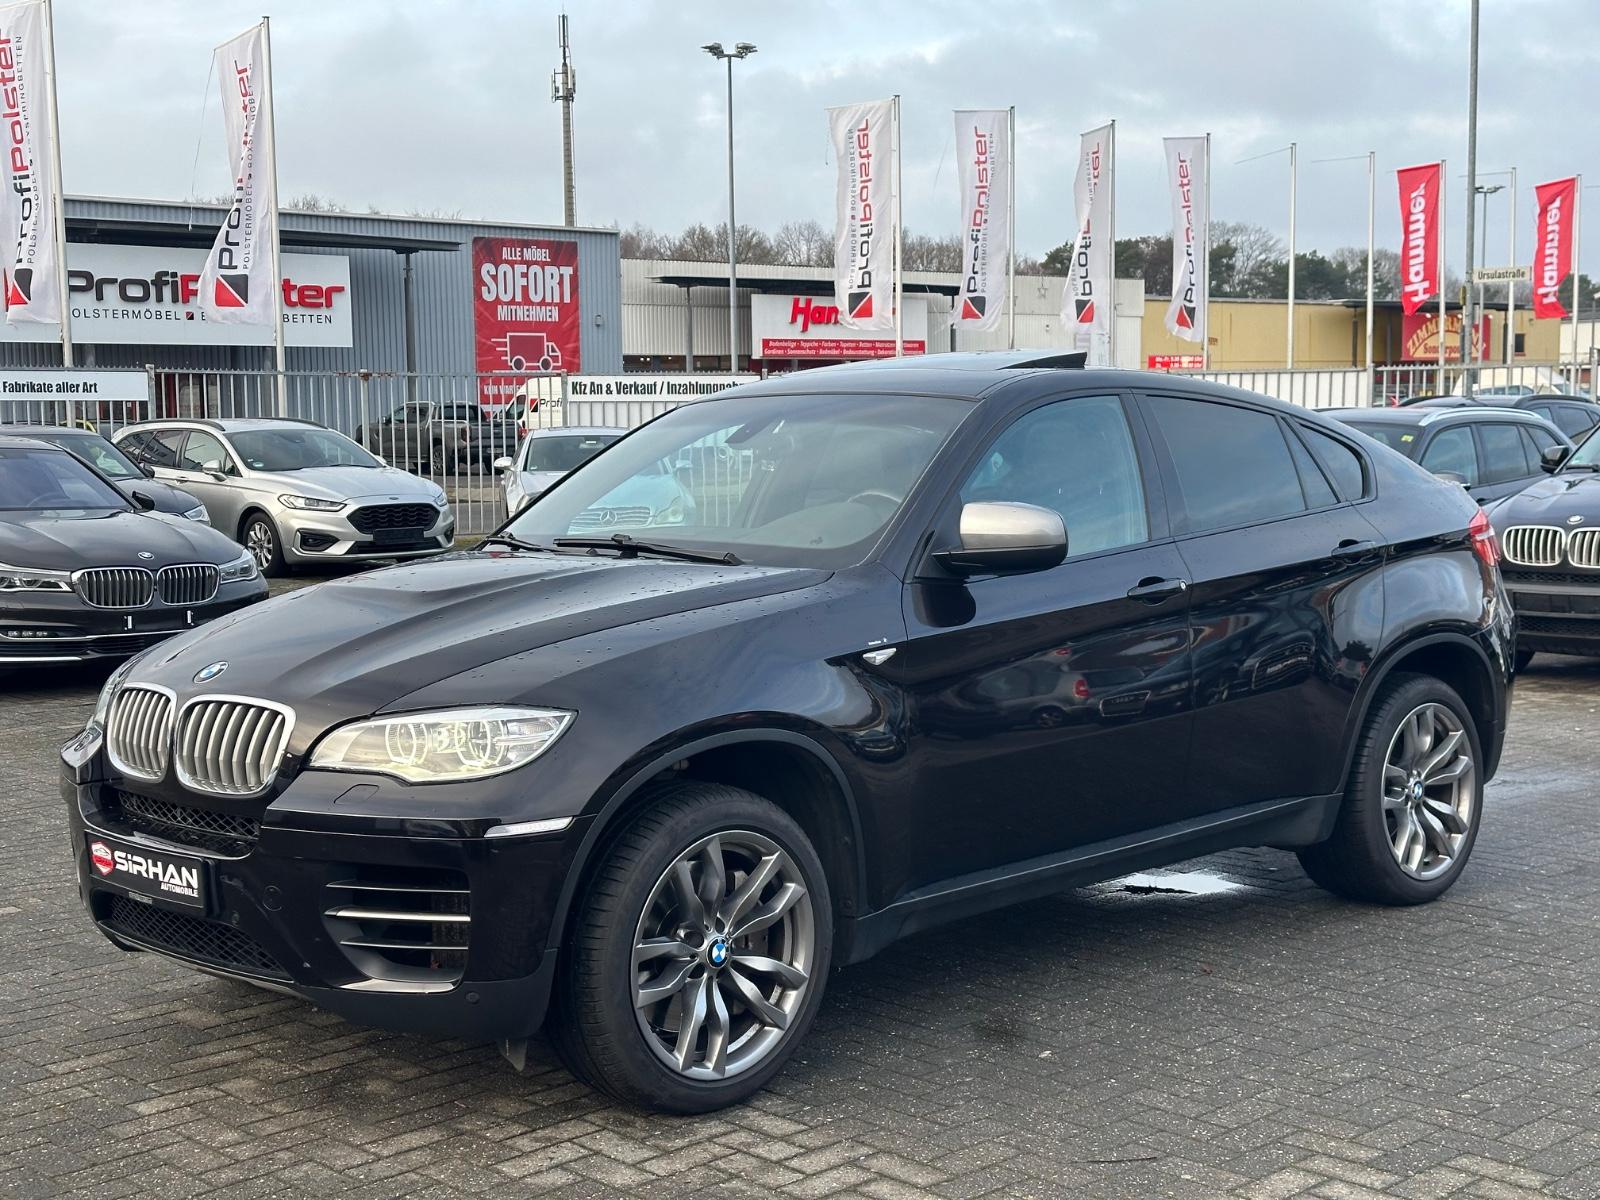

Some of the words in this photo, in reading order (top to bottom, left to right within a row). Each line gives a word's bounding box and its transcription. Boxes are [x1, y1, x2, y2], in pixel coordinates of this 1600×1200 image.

[502, 247, 521, 260] ALLE
[523, 245, 551, 261] MÖBEL
[1477, 268, 1526, 280] Ursulastraße
[480, 262, 573, 303] SOFORT
[72, 308, 181, 321] OLSTERMÖBEL
[497, 304, 559, 322] MITNEHMEN
[2, 381, 53, 394] Fabrikate
[55, 381, 80, 393] aller
[82, 382, 98, 393] Art
[571, 381, 587, 395] Kfz
[589, 382, 602, 395] An
[605, 383, 613, 395] &
[616, 381, 657, 395] Verkauf
[659, 382, 664, 395] /
[539, 398, 563, 408] Profi
[160, 882, 199, 897] AUTOMOBILE
